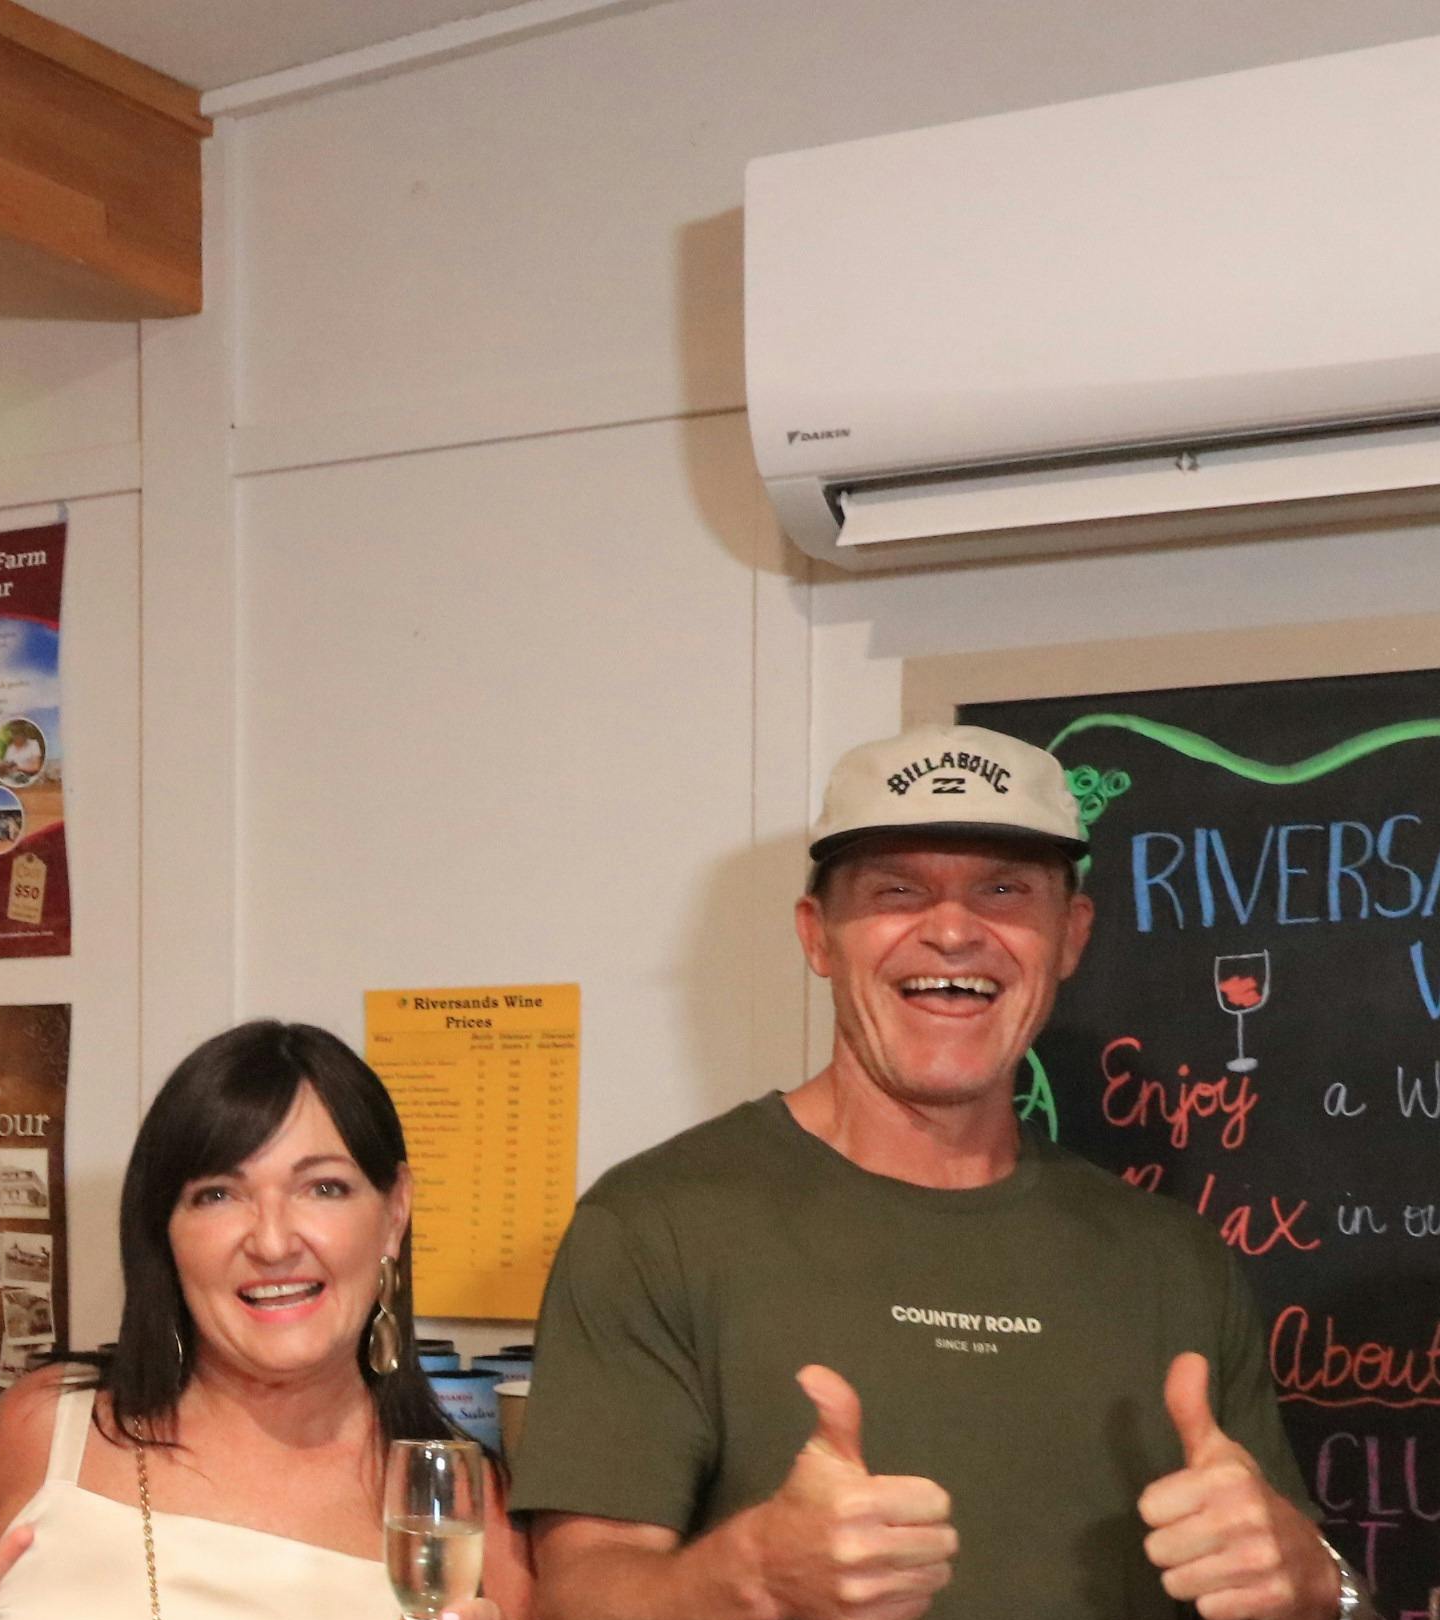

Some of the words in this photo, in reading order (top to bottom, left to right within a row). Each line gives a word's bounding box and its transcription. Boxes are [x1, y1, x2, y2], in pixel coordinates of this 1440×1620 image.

[801, 429, 851, 442] DAIKIN
[887, 751, 1012, 797] BILLABONG
[414, 995, 499, 1010] Riversands
[504, 995, 543, 1009] Wine
[446, 1016, 493, 1030] Prices
[1101, 1036, 1260, 1149] Enjoy
[1323, 1081, 1367, 1117] a
[1337, 1192, 1386, 1235] in
[891, 1304, 982, 1332] COUNTRY
[985, 1316, 1043, 1334] ROAD
[935, 1337, 970, 1353] SINCE
[972, 1342, 999, 1355] 1974
